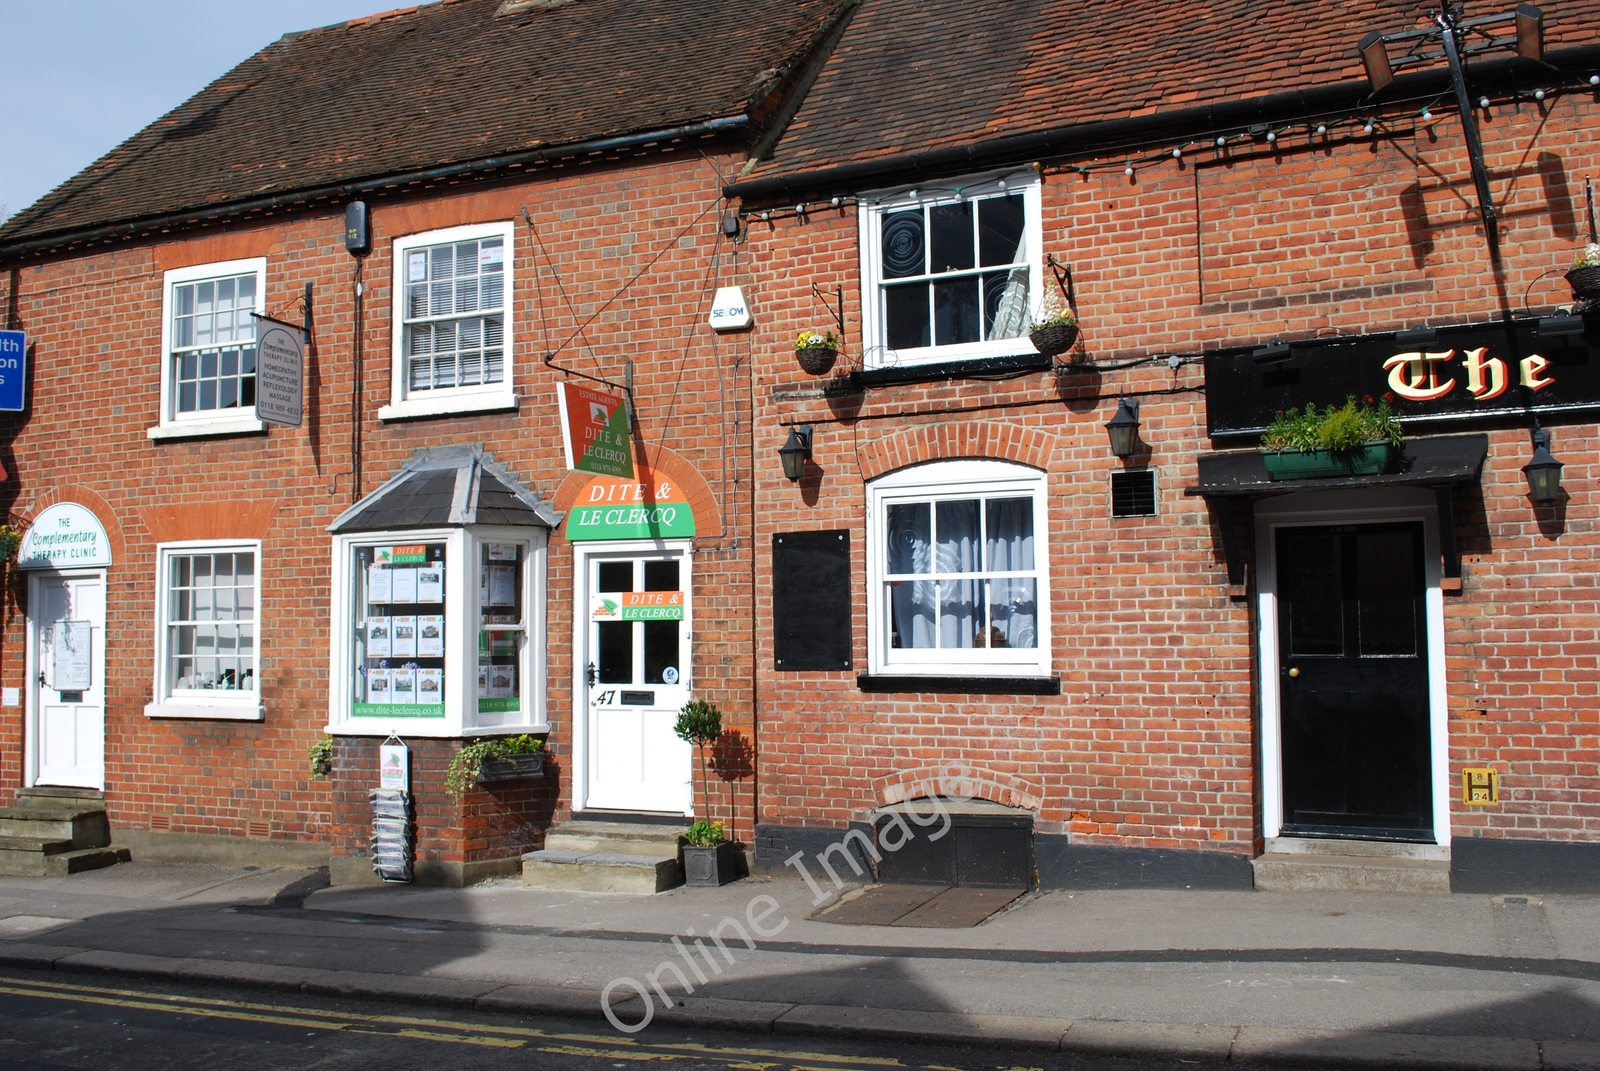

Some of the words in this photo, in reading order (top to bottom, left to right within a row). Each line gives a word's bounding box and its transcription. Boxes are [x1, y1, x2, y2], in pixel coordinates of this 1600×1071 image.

[713, 307, 744, 318] SECOM
[277, 338, 285, 346] THE
[263, 341, 298, 360] Complementary
[263, 351, 283, 362] THERAPY
[284, 356, 298, 366] CLINIC
[264, 363, 297, 377] HOMEOPATHY
[1382, 347, 1556, 400] The
[262, 372, 299, 386] ACUPUNCTURE
[263, 380, 298, 395] REFLEXOLOGY
[269, 392, 292, 403] MASSAGE
[579, 390, 597, 401] ESTATE
[598, 395, 618, 407] AGENTS
[260, 400, 274, 410] 0118
[275, 403, 285, 413] 989
[286, 405, 300, 416] 4832
[584, 426, 611, 443] DITE
[615, 434, 623, 446] &
[583, 444, 594, 457] LE
[594, 446, 627, 466] CLERCQ
[591, 462, 602, 471] 0118
[611, 466, 623, 475] 4995
[588, 483, 647, 502] DITE
[655, 482, 672, 499] &
[58, 518, 70, 527] THE
[578, 510, 603, 526] LE
[605, 507, 677, 527] CLERCQ
[32, 530, 97, 548] Complementary
[32, 549, 67, 560] THERAPY
[70, 547, 97, 558] CLINIC
[402, 555, 425, 563] CLERCQ
[630, 594, 664, 605] DITE
[669, 593, 679, 604] &
[624, 608, 638, 618] LE
[640, 608, 681, 619] CLERCQ
[597, 690, 616, 705] 47
[355, 705, 443, 717] www.dite-leclercq.co.uk
[493, 701, 505, 709] 979
[1477, 773, 1483, 781] 8
[1468, 772, 1493, 801] H
[1474, 792, 1488, 800] 24
